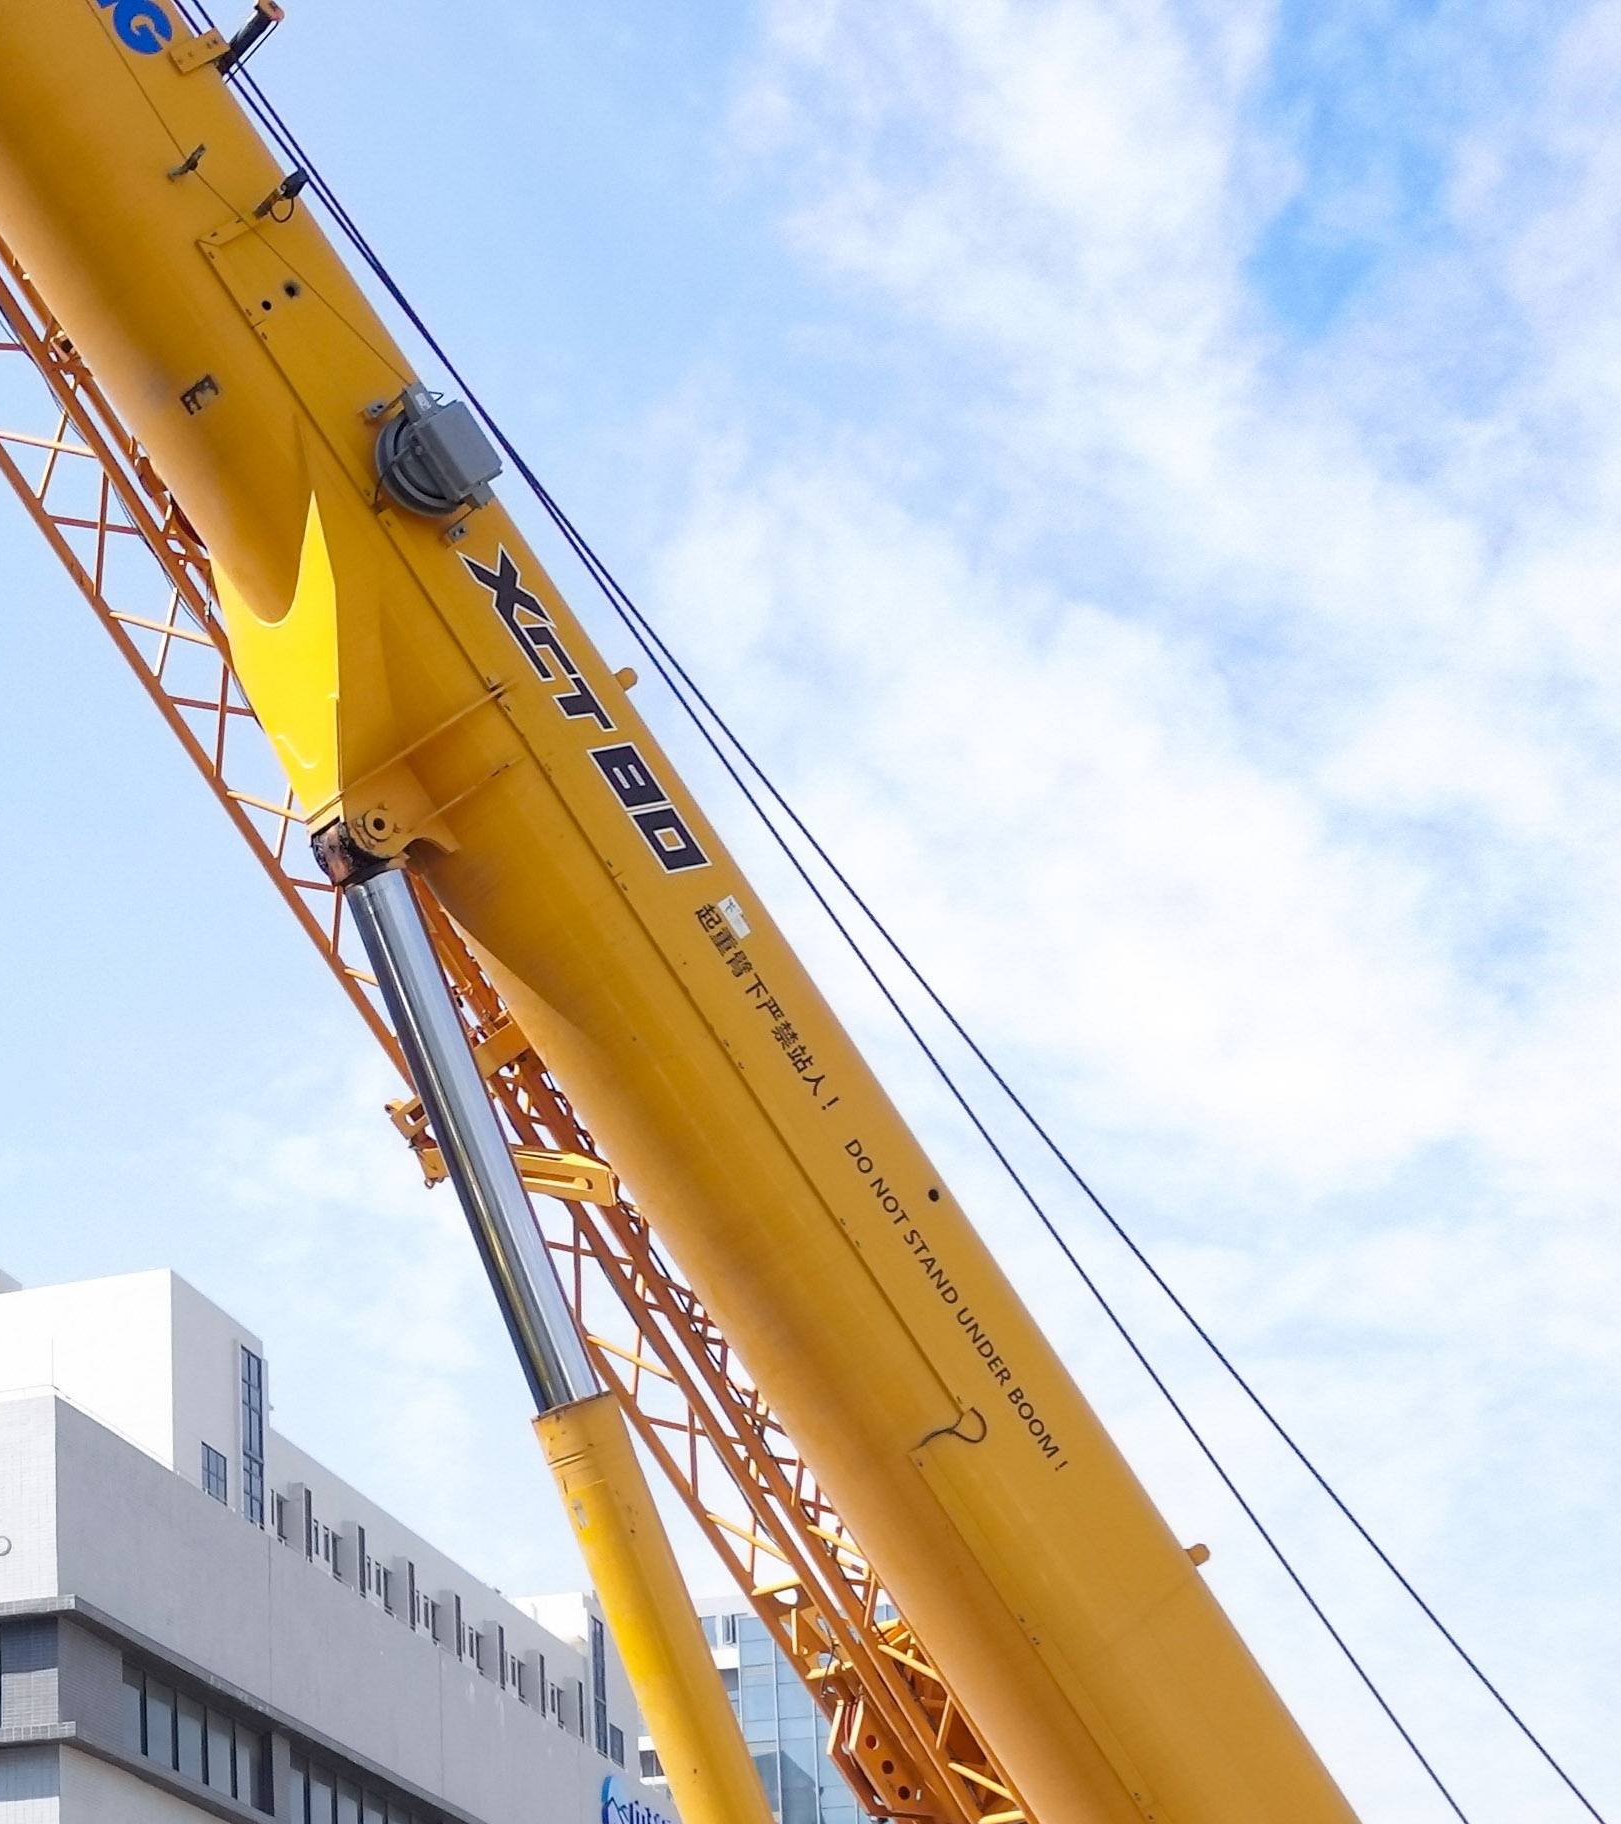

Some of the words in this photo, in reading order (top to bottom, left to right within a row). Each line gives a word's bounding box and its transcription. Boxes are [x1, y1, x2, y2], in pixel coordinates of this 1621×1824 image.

[844, 1138, 874, 1175] DO
[869, 1176, 911, 1226] NOT
[902, 1228, 959, 1305] STAND
[955, 1306, 1012, 1387] UNDER
